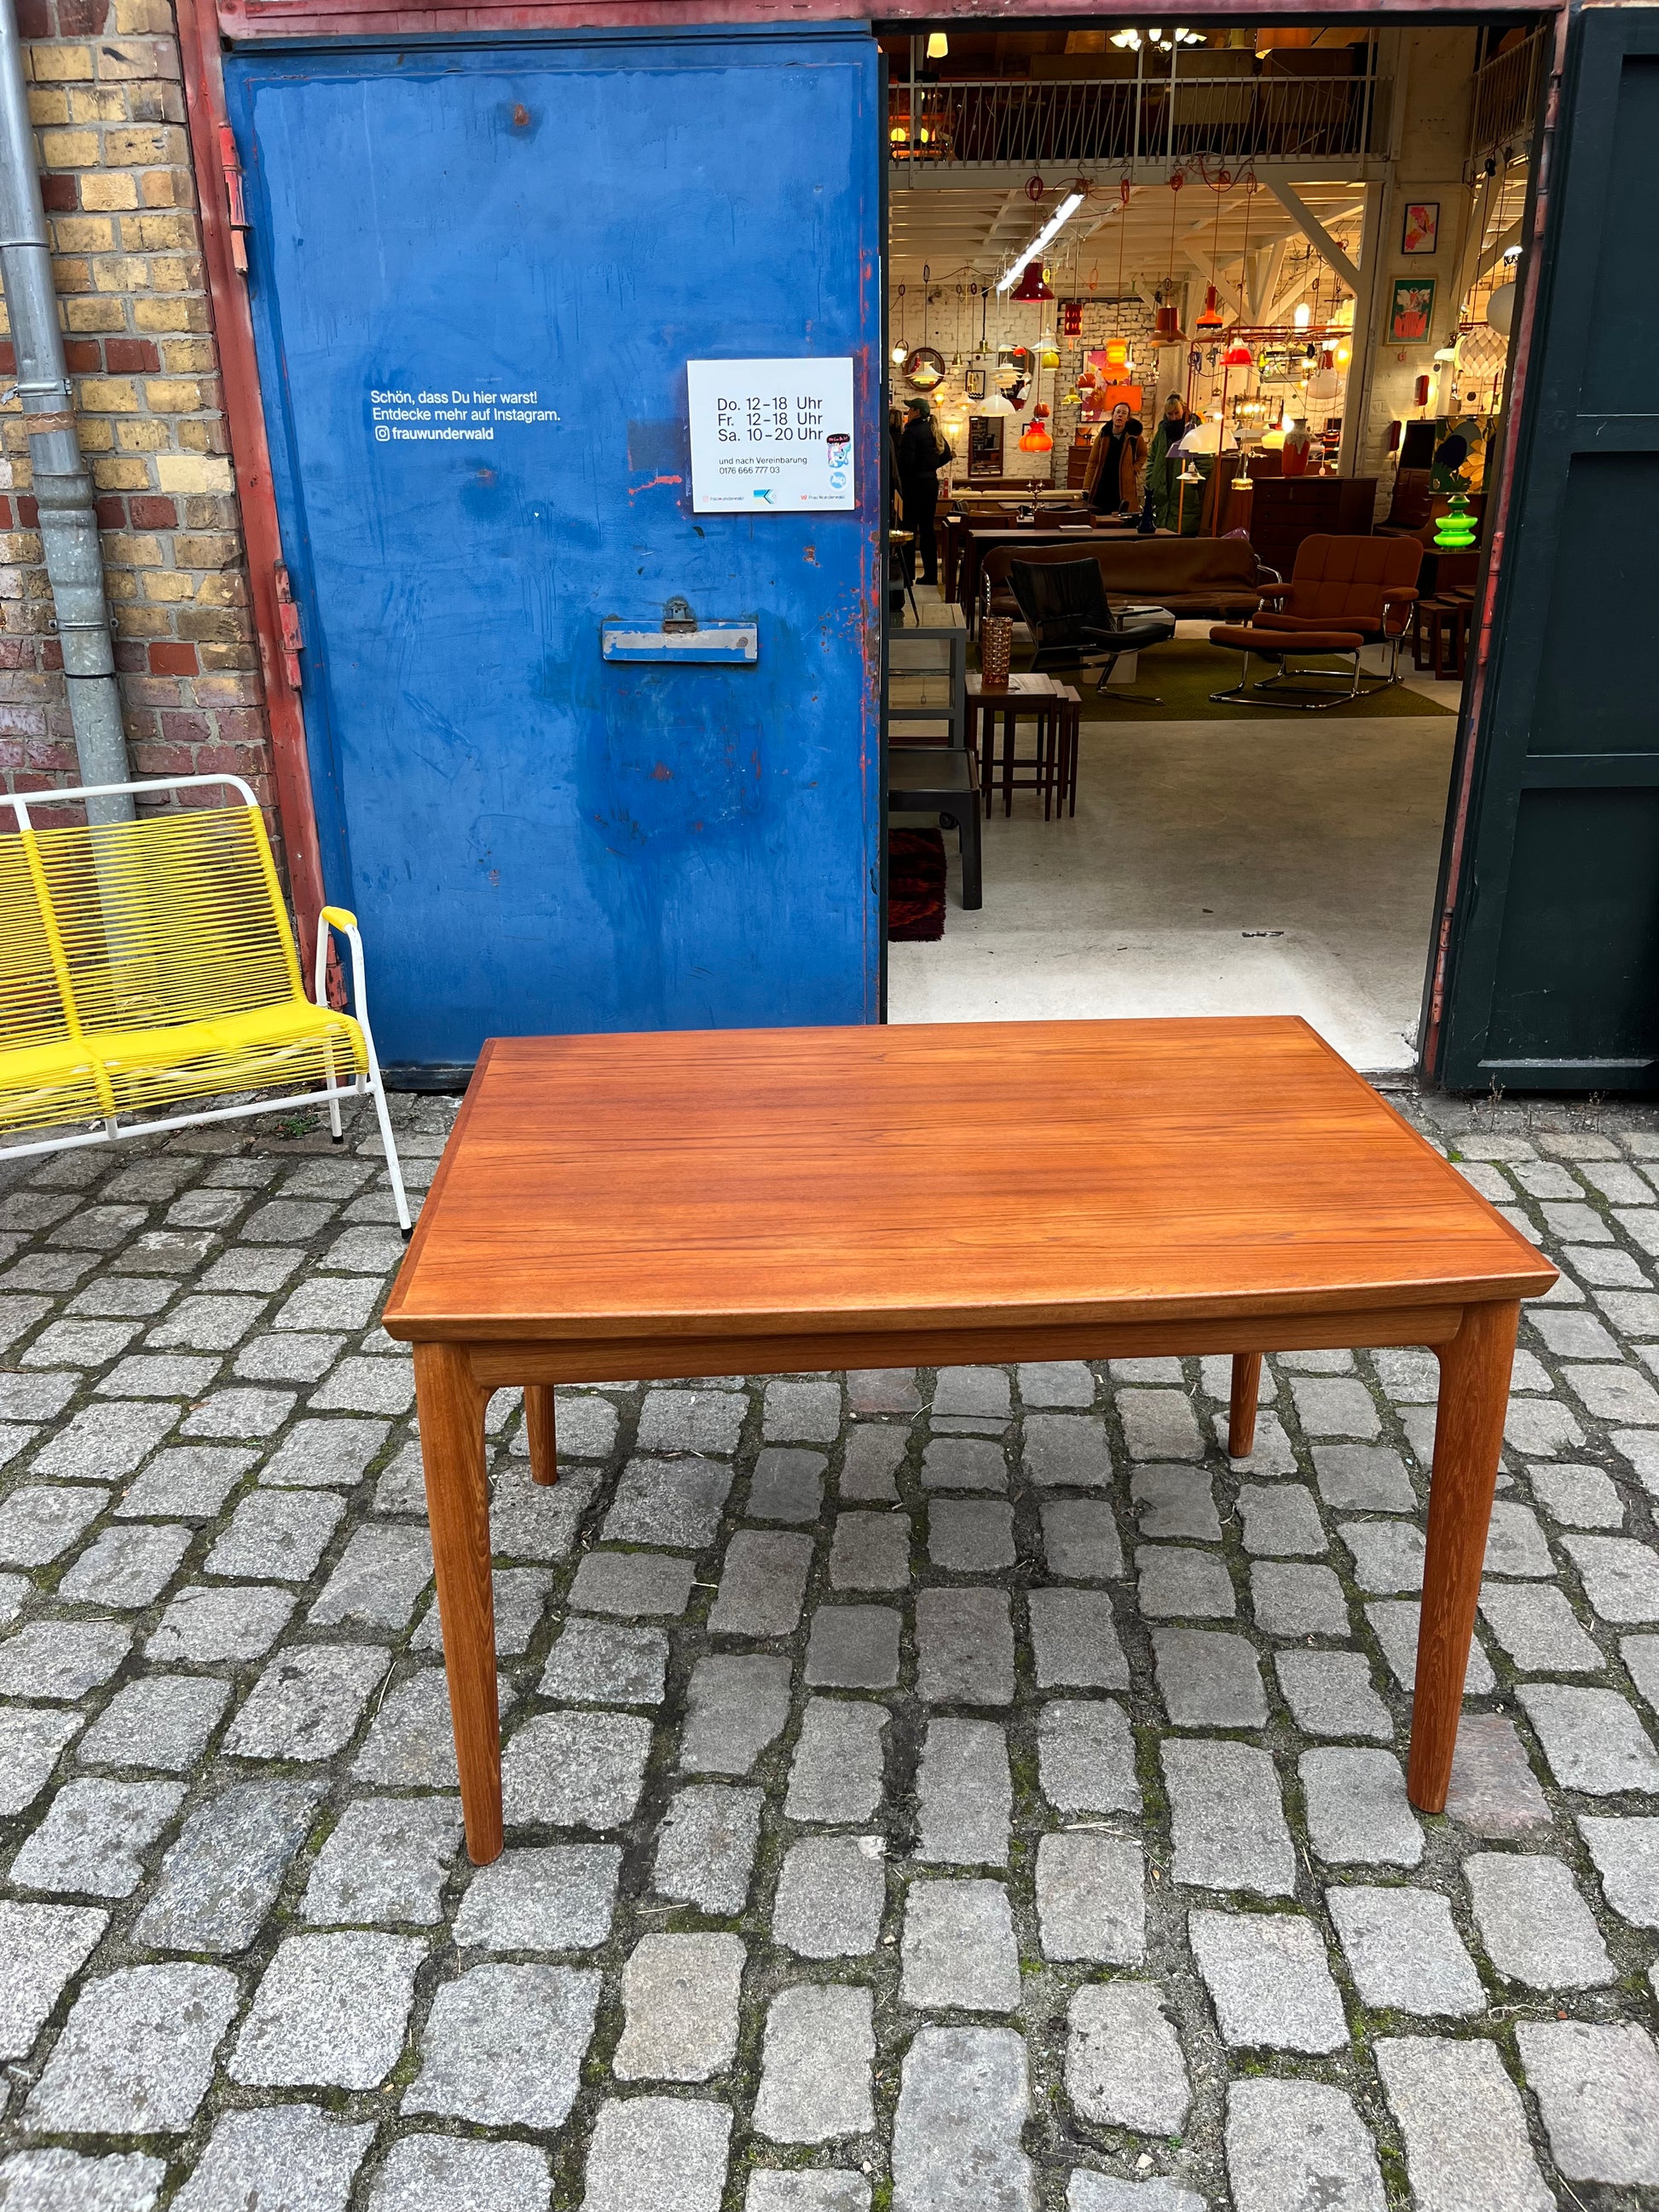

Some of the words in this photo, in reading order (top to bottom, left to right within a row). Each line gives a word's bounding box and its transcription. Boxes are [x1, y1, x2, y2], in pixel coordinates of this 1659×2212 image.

[370, 390, 415, 406] Schön,
[418, 391, 449, 404] dass
[452, 391, 470, 404] Du
[473, 391, 497, 404] hier
[500, 391, 538, 404] warst!
[717, 398, 741, 411] Do.
[797, 396, 824, 409] Uhr
[373, 407, 431, 421] Entdecke
[435, 408, 468, 421] mehr
[471, 408, 491, 421] auf
[494, 408, 561, 424] Instagram.
[718, 413, 735, 426] Fr.
[797, 413, 824, 425] Uhr
[391, 427, 494, 440] frauwunderwald
[718, 429, 741, 442] Sa.
[797, 428, 824, 441] Uhr
[755, 457, 807, 465] Vereinbarung
